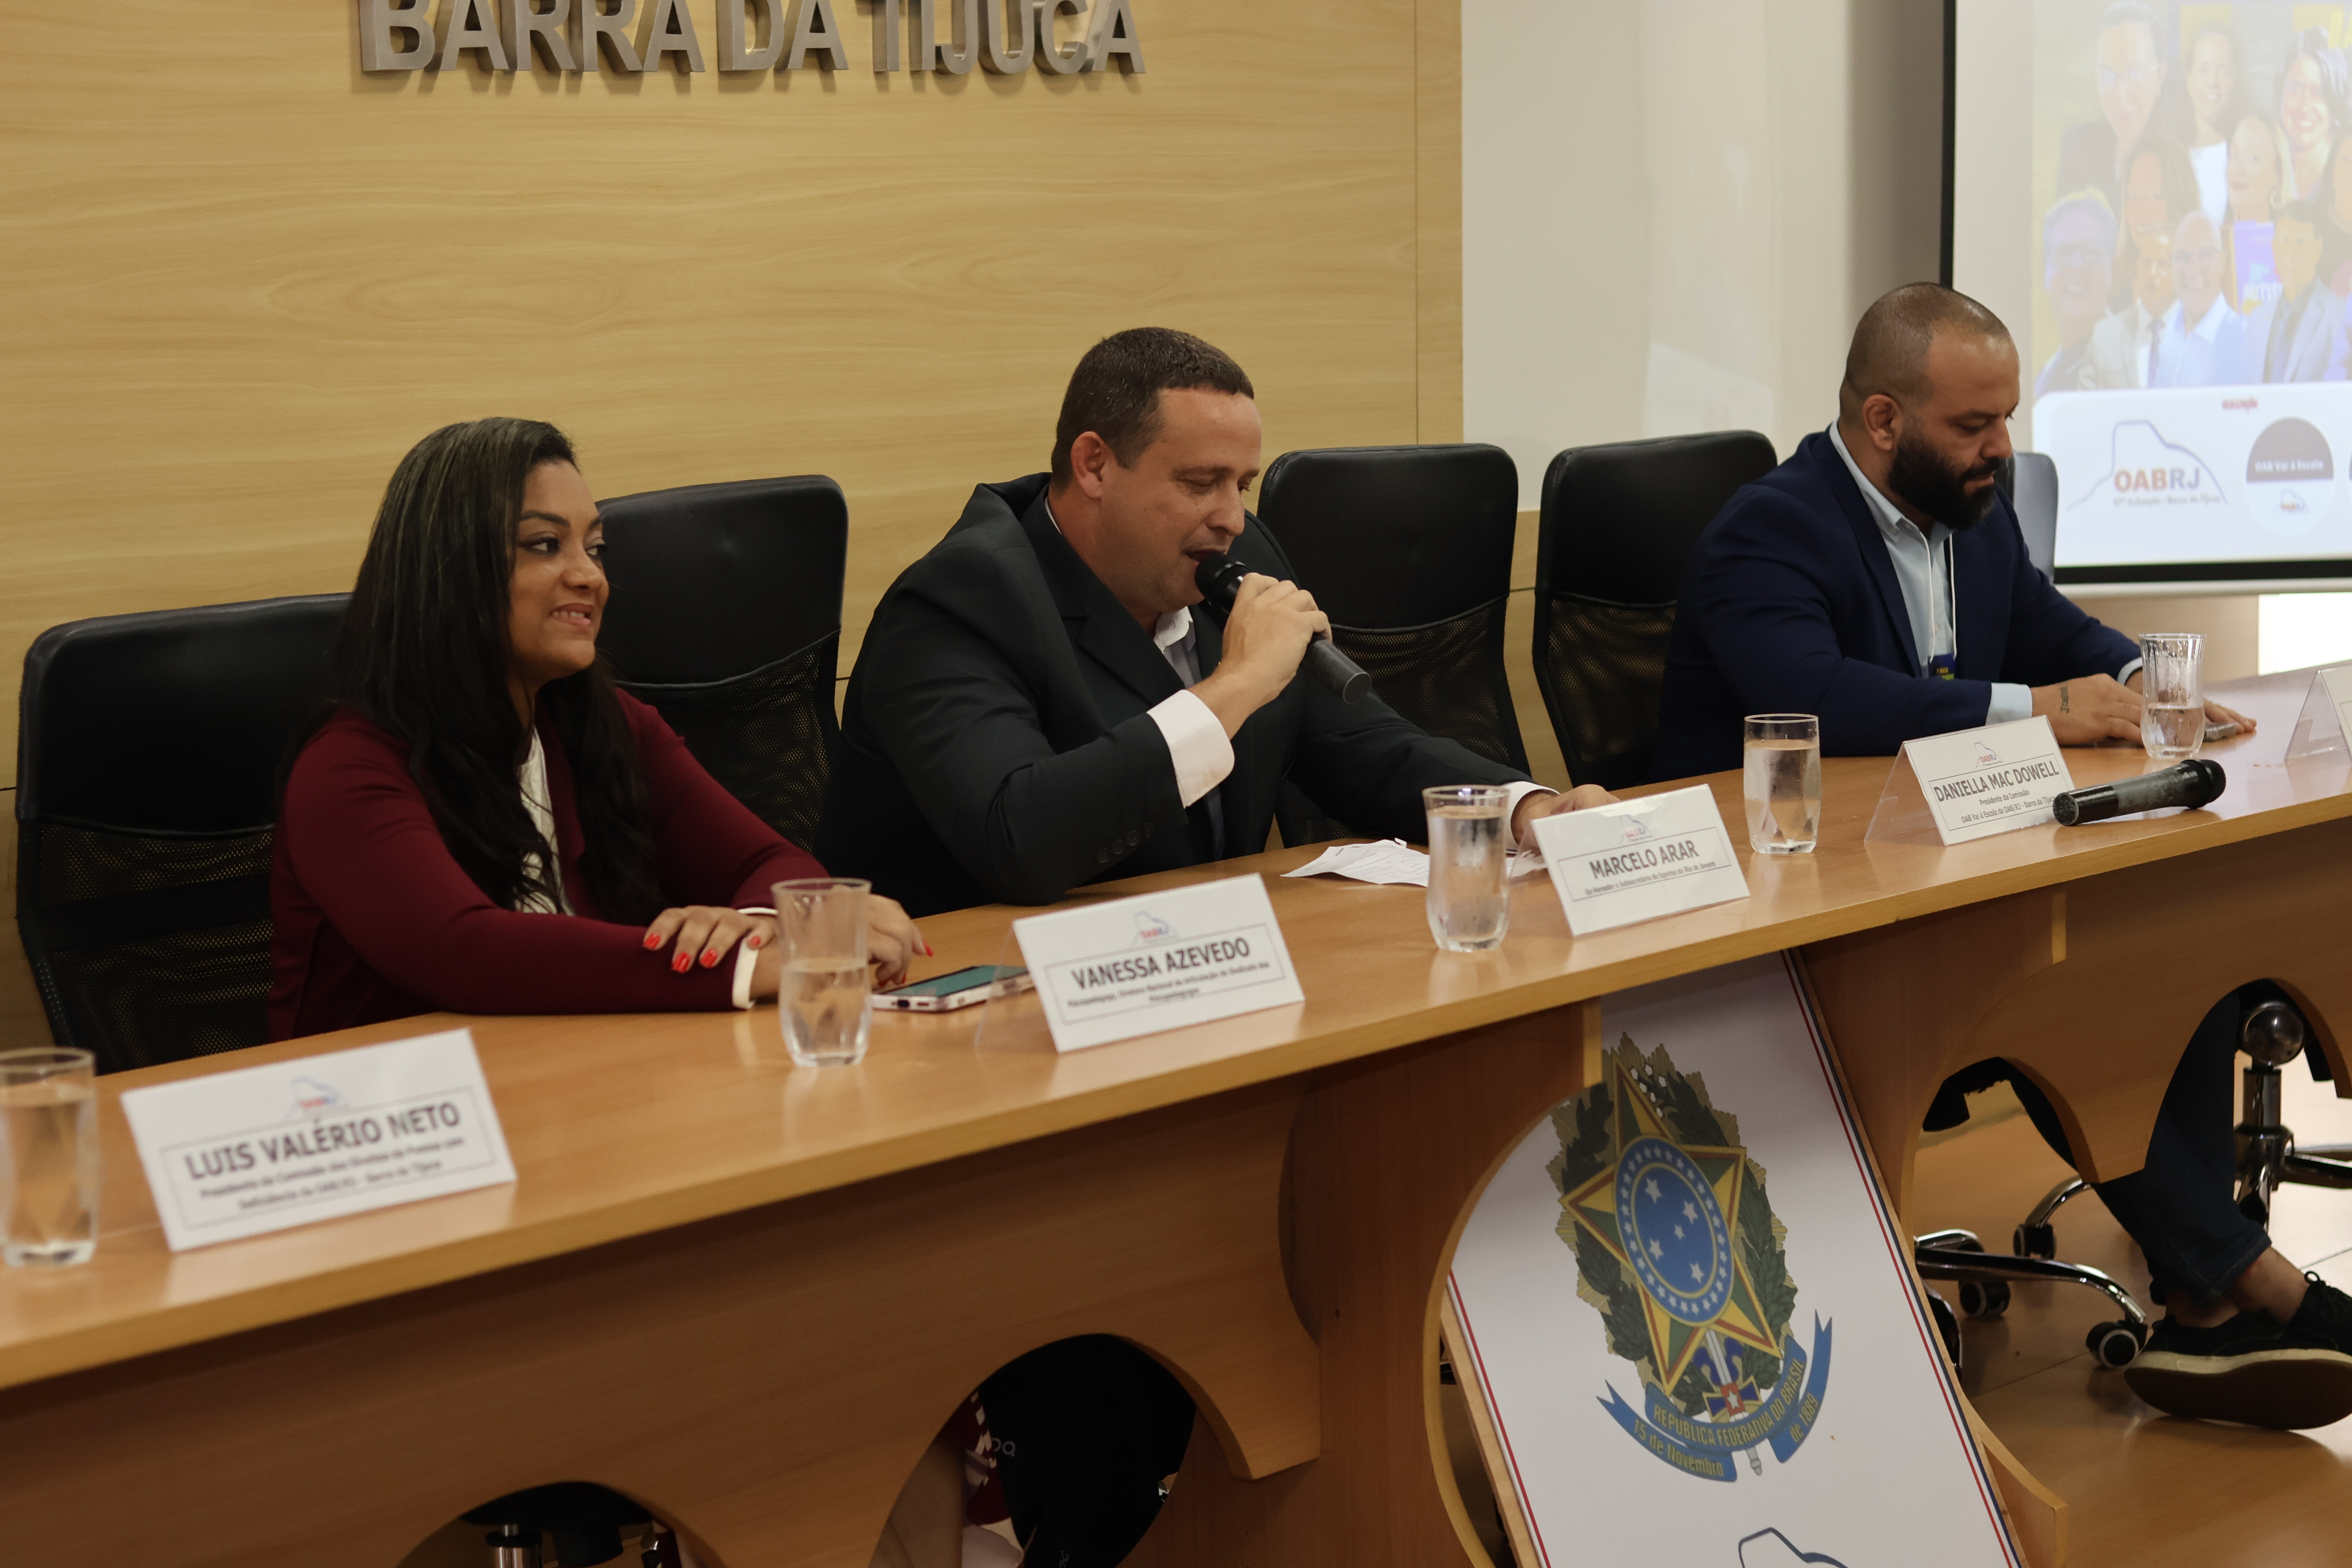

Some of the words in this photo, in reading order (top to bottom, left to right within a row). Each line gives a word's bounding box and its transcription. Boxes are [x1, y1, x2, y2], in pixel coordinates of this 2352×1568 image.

[361, 0, 706, 73] BARRA
[719, 0, 849, 72] DA
[873, 0, 1146, 74] TIJUCA
[2114, 466, 2200, 492] OABRJ
[1933, 776, 1991, 802] DANIELLA
[1987, 770, 2014, 790] MAC
[2012, 760, 2060, 784] DOWELL
[1978, 796, 2003, 806] Presidente
[2008, 789, 2030, 799] Comissão
[1961, 815, 1972, 823] OAB
[1971, 812, 1980, 820] Vai
[1983, 808, 1998, 818] Escola
[2003, 803, 2021, 813] OAB/RJ
[2042, 795, 2055, 805] Tijuc
[1589, 849, 1657, 879] MARCELO
[1659, 840, 1700, 864] ARAR
[1071, 956, 1162, 990] VANESSA
[1165, 937, 1250, 973] AZEVEDO
[183, 1142, 256, 1179] LUIS
[259, 1116, 382, 1163] VALÉRIO
[387, 1102, 460, 1139] NETO
[1654, 1404, 1717, 1446] REPUBLICA
[1717, 1411, 1775, 1447] FEDERATIVA
[1770, 1397, 1785, 1421] DO
[1780, 1357, 1804, 1405] BRASIL
[1634, 1419, 1646, 1441] 15
[1649, 1434, 1664, 1454] de
[1667, 1443, 1724, 1477] Novembro
[1790, 1424, 1803, 1443] de
[1798, 1392, 1818, 1426] 1889
